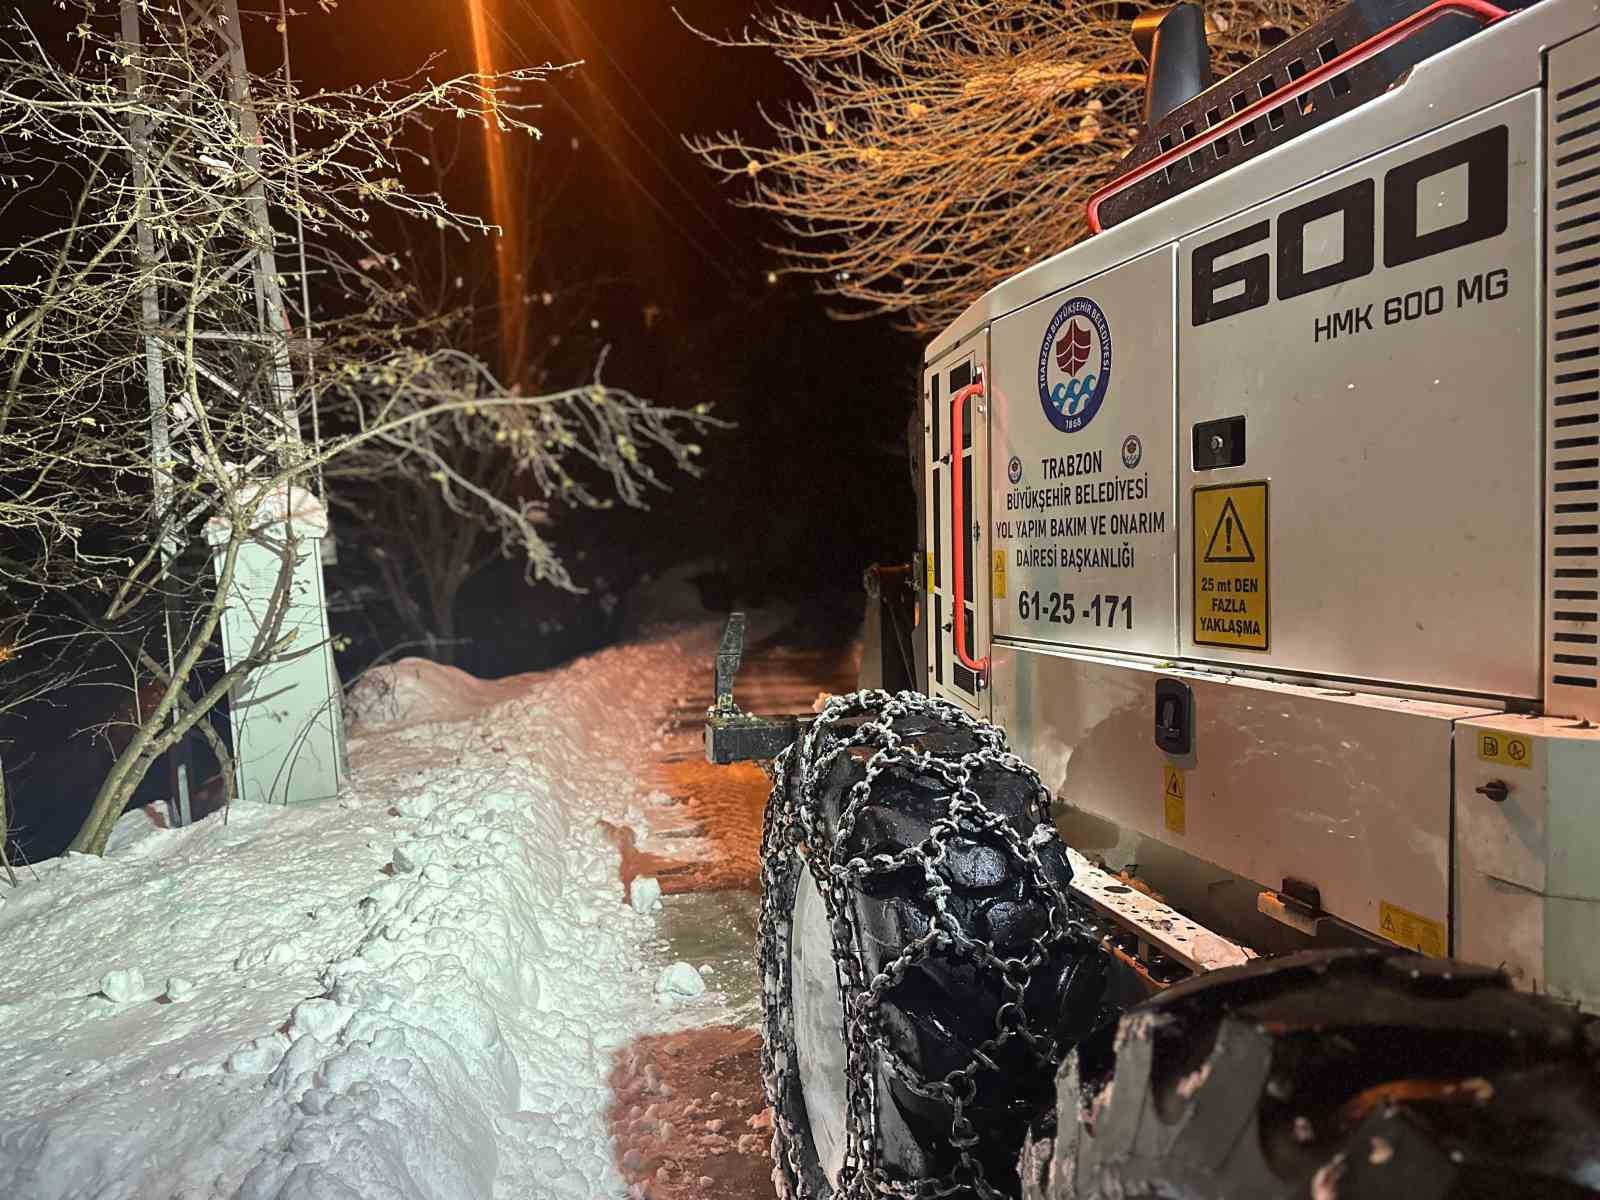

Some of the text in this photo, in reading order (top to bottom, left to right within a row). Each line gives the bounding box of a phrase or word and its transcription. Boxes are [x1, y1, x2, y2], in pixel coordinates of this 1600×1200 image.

[1191, 124, 1509, 327] 600
[1313, 268, 1509, 343] HMK 600 MG
[1041, 450, 1103, 480] TRABZON
[1007, 472, 1148, 512] BÜYÜKŞEHİR BELEDİYESİ
[996, 511, 1165, 539] YOL YAPIM BAKIM VE ONARIM
[1016, 542, 1135, 573] DAİRESİ BAŞKANLIĞI
[1201, 577, 1259, 594] 25 mt DEN
[1211, 598, 1247, 614] FAZLA
[1200, 616, 1262, 638] YAKLAŞMA
